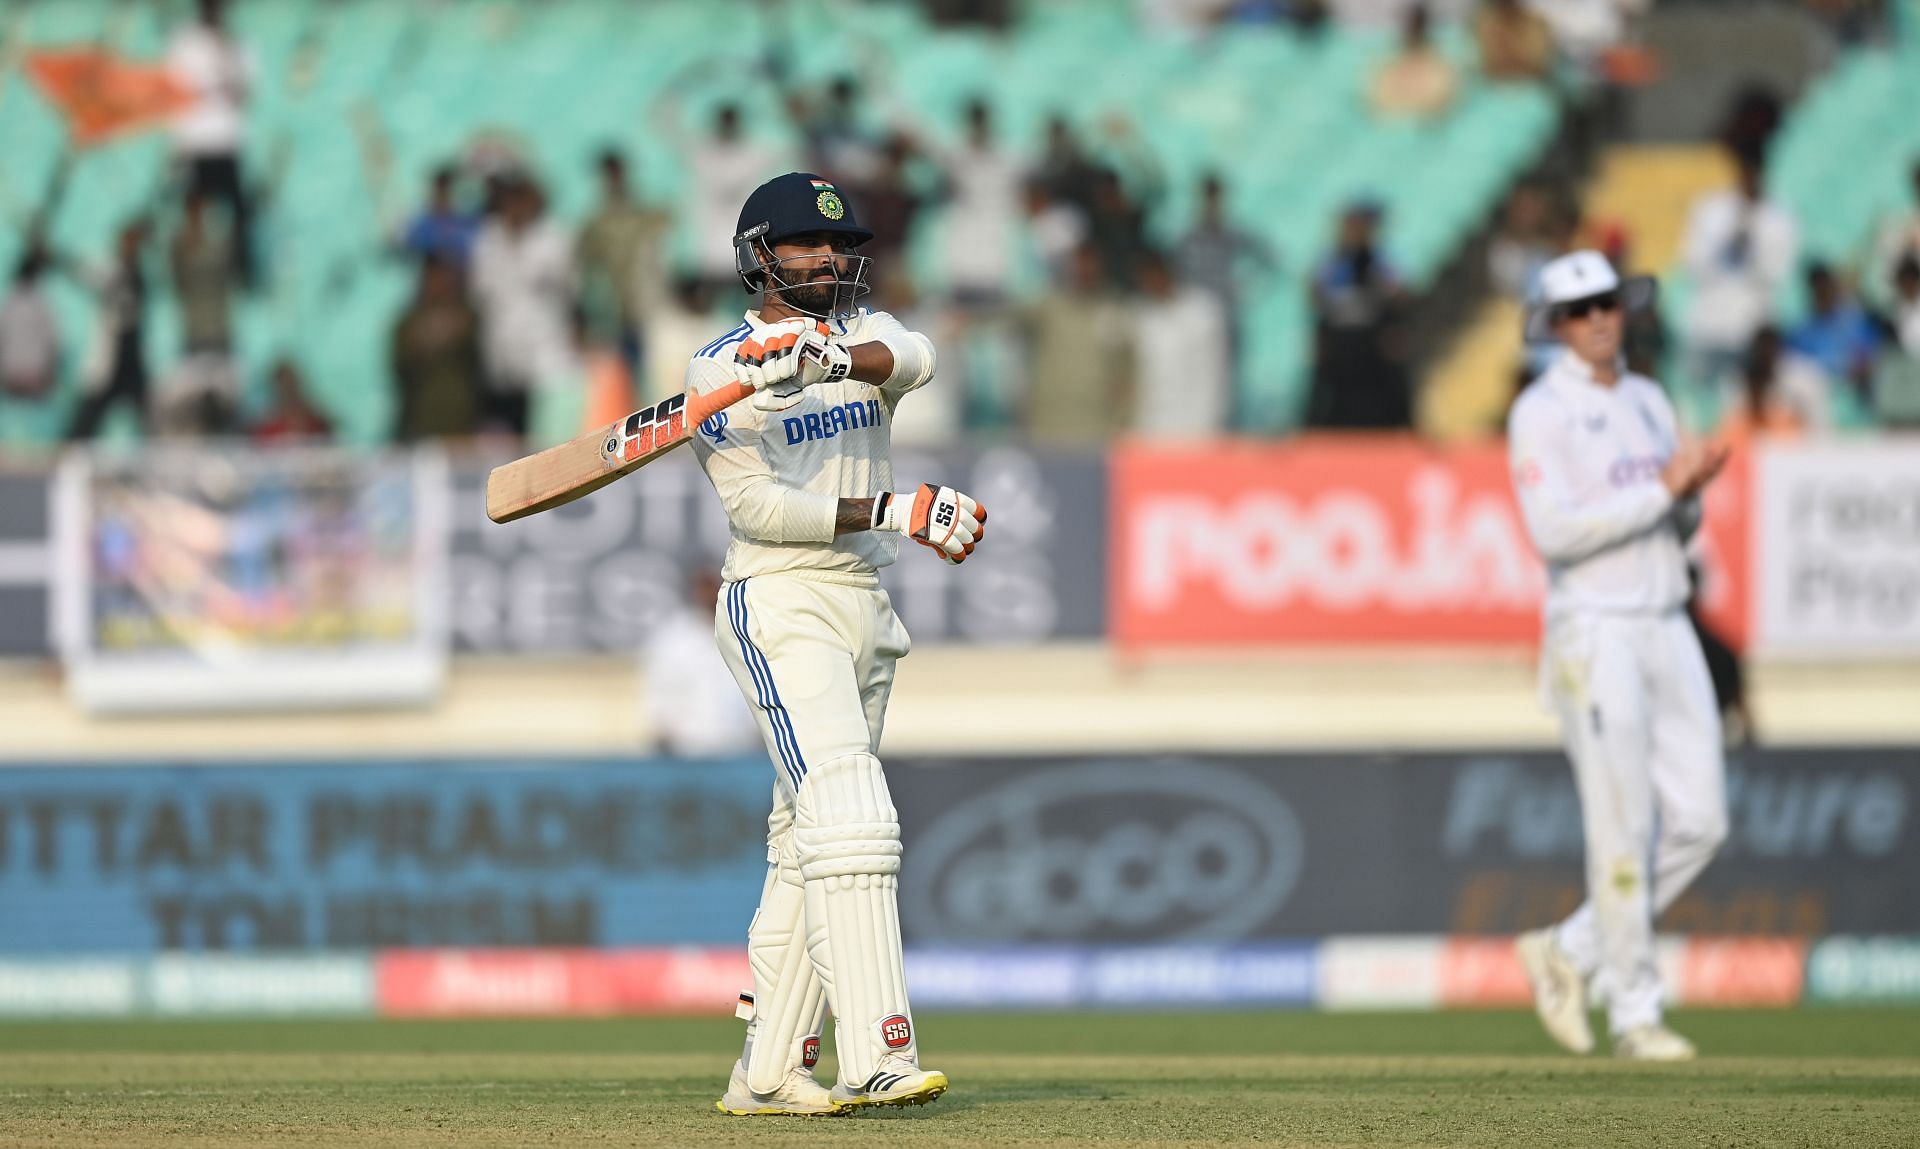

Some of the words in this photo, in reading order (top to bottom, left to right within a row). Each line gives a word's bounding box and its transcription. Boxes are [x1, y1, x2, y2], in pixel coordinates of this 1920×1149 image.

[743, 225, 761, 239] SHREY
[625, 393, 685, 462] SS
[783, 399, 881, 445] DREAM11
[935, 502, 955, 527] SS
[0, 796, 268, 870] TTAR
[885, 1022, 909, 1041] SS
[806, 1044, 820, 1060] SS
